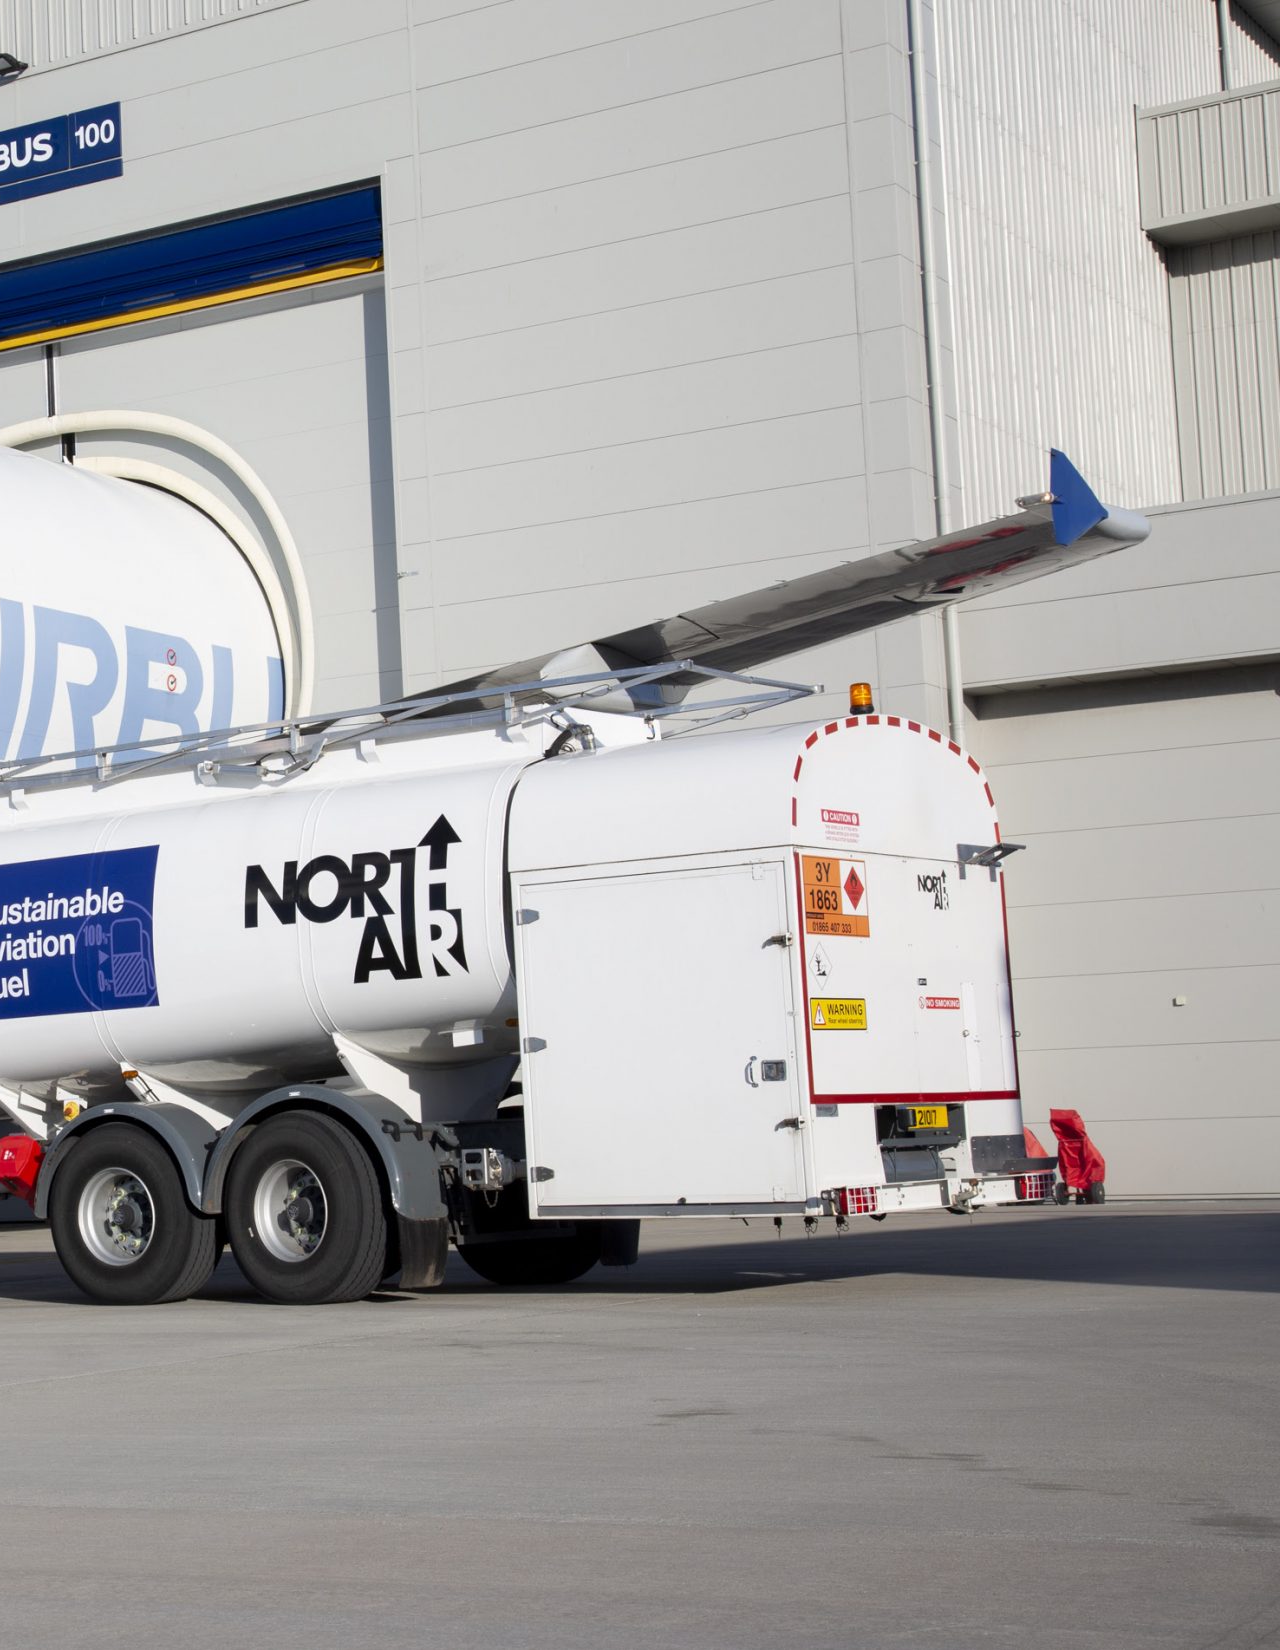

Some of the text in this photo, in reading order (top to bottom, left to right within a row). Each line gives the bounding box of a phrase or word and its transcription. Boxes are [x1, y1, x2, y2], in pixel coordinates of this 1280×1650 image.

[74, 118, 115, 150] 100
[829, 811, 852, 823] CAUTION
[815, 862, 831, 883] 3Y
[809, 888, 839, 911] 1863
[827, 1003, 863, 1016] WARNING
[926, 999, 960, 1008] NO SMOKING
